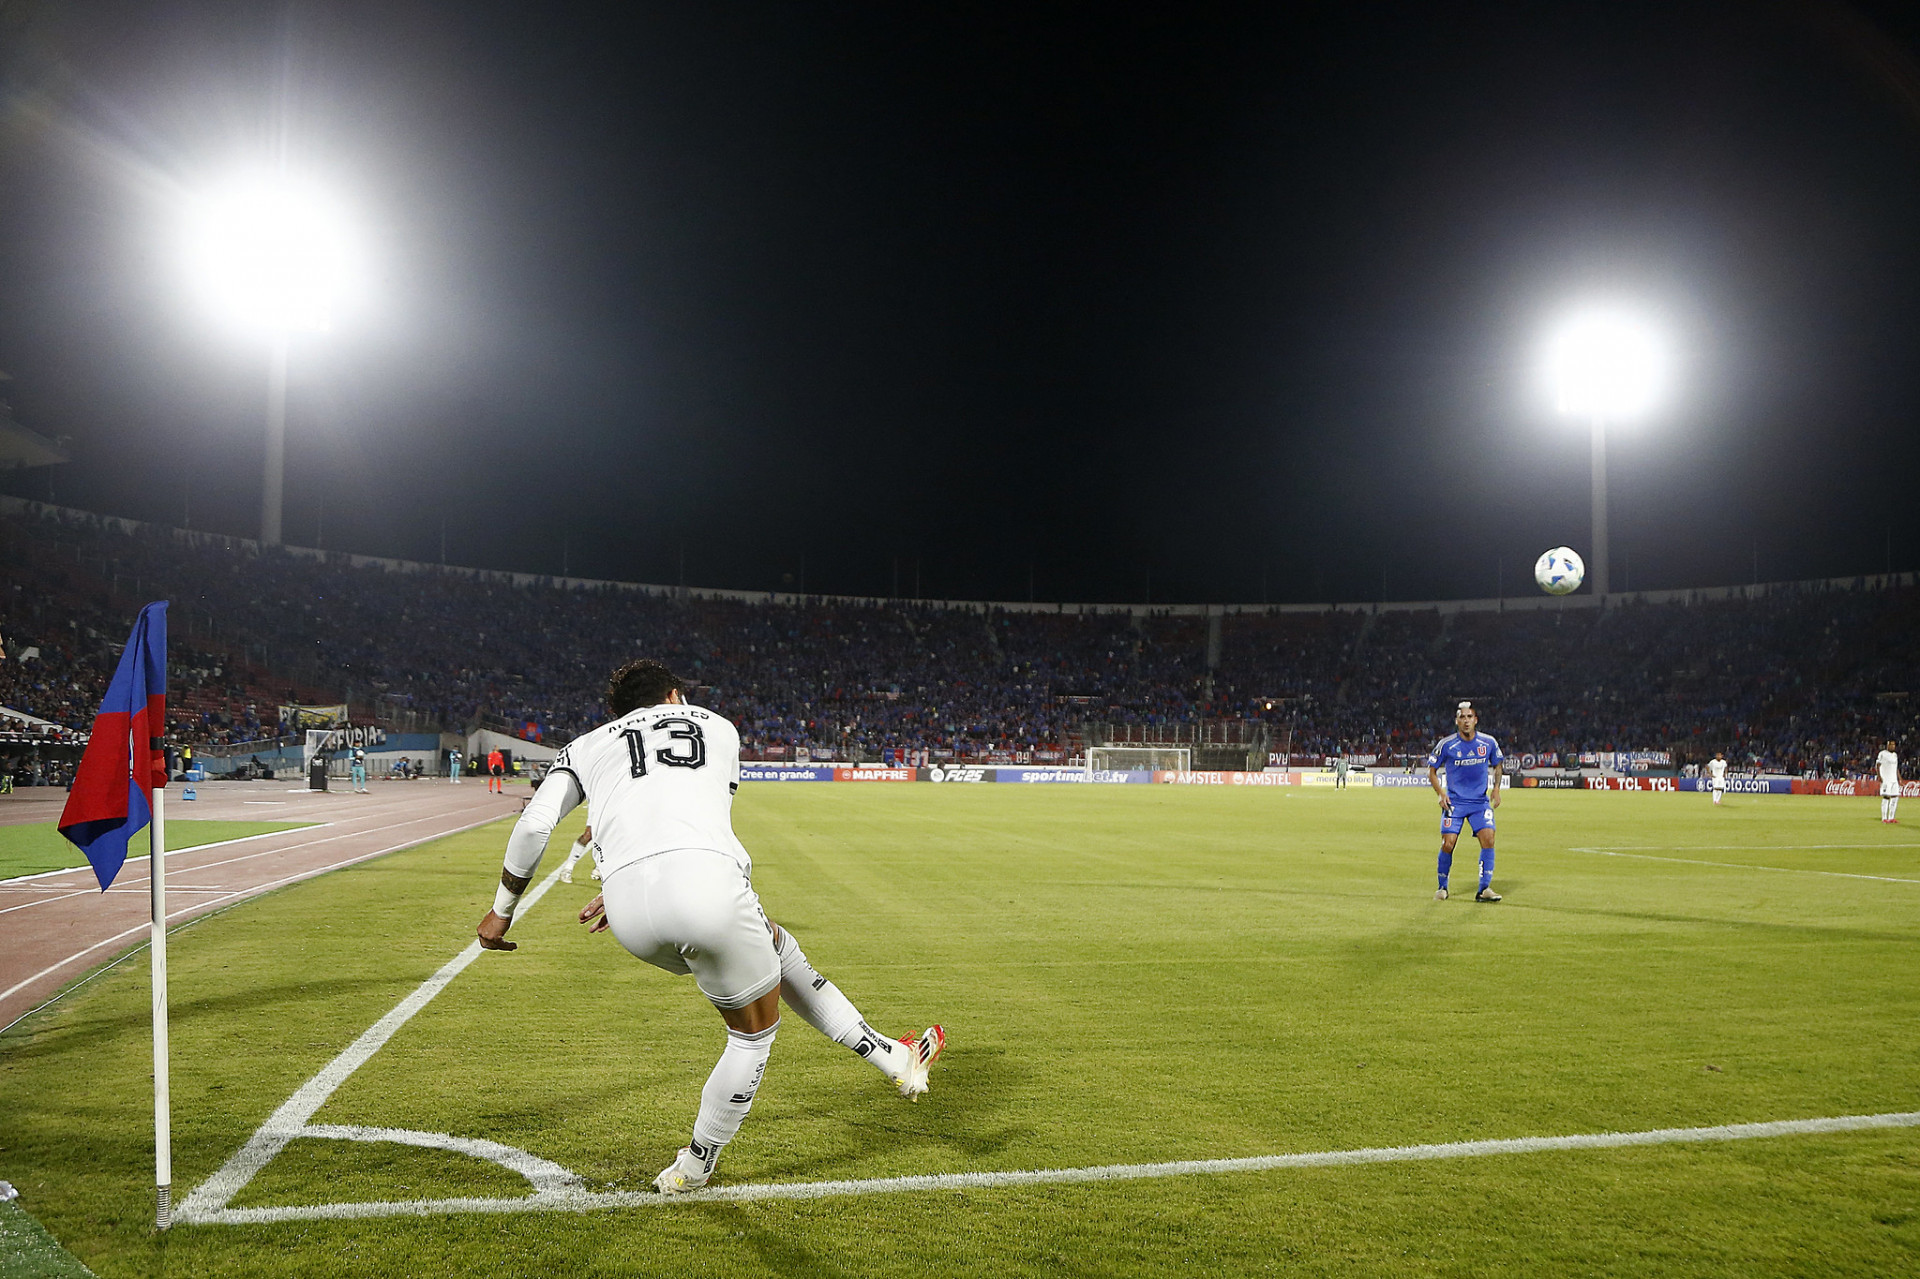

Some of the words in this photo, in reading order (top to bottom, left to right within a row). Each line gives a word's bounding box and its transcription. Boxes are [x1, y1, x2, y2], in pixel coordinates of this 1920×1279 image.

[618, 718, 706, 779] 13
[741, 770, 763, 779] Cree
[765, 771, 778, 779] en
[852, 770, 908, 780] MAPFRE
[1178, 772, 1223, 784] AMSTEL
[1245, 773, 1291, 785] AMSTEL
[1354, 775, 1371, 784] libre
[1386, 776, 1441, 786] crypto.co
[1539, 777, 1573, 787] priceless
[1587, 778, 1610, 790] TCL
[1617, 778, 1642, 790] TCL
[1648, 778, 1675, 791] TCL
[1706, 779, 1769, 793] cpto.com
